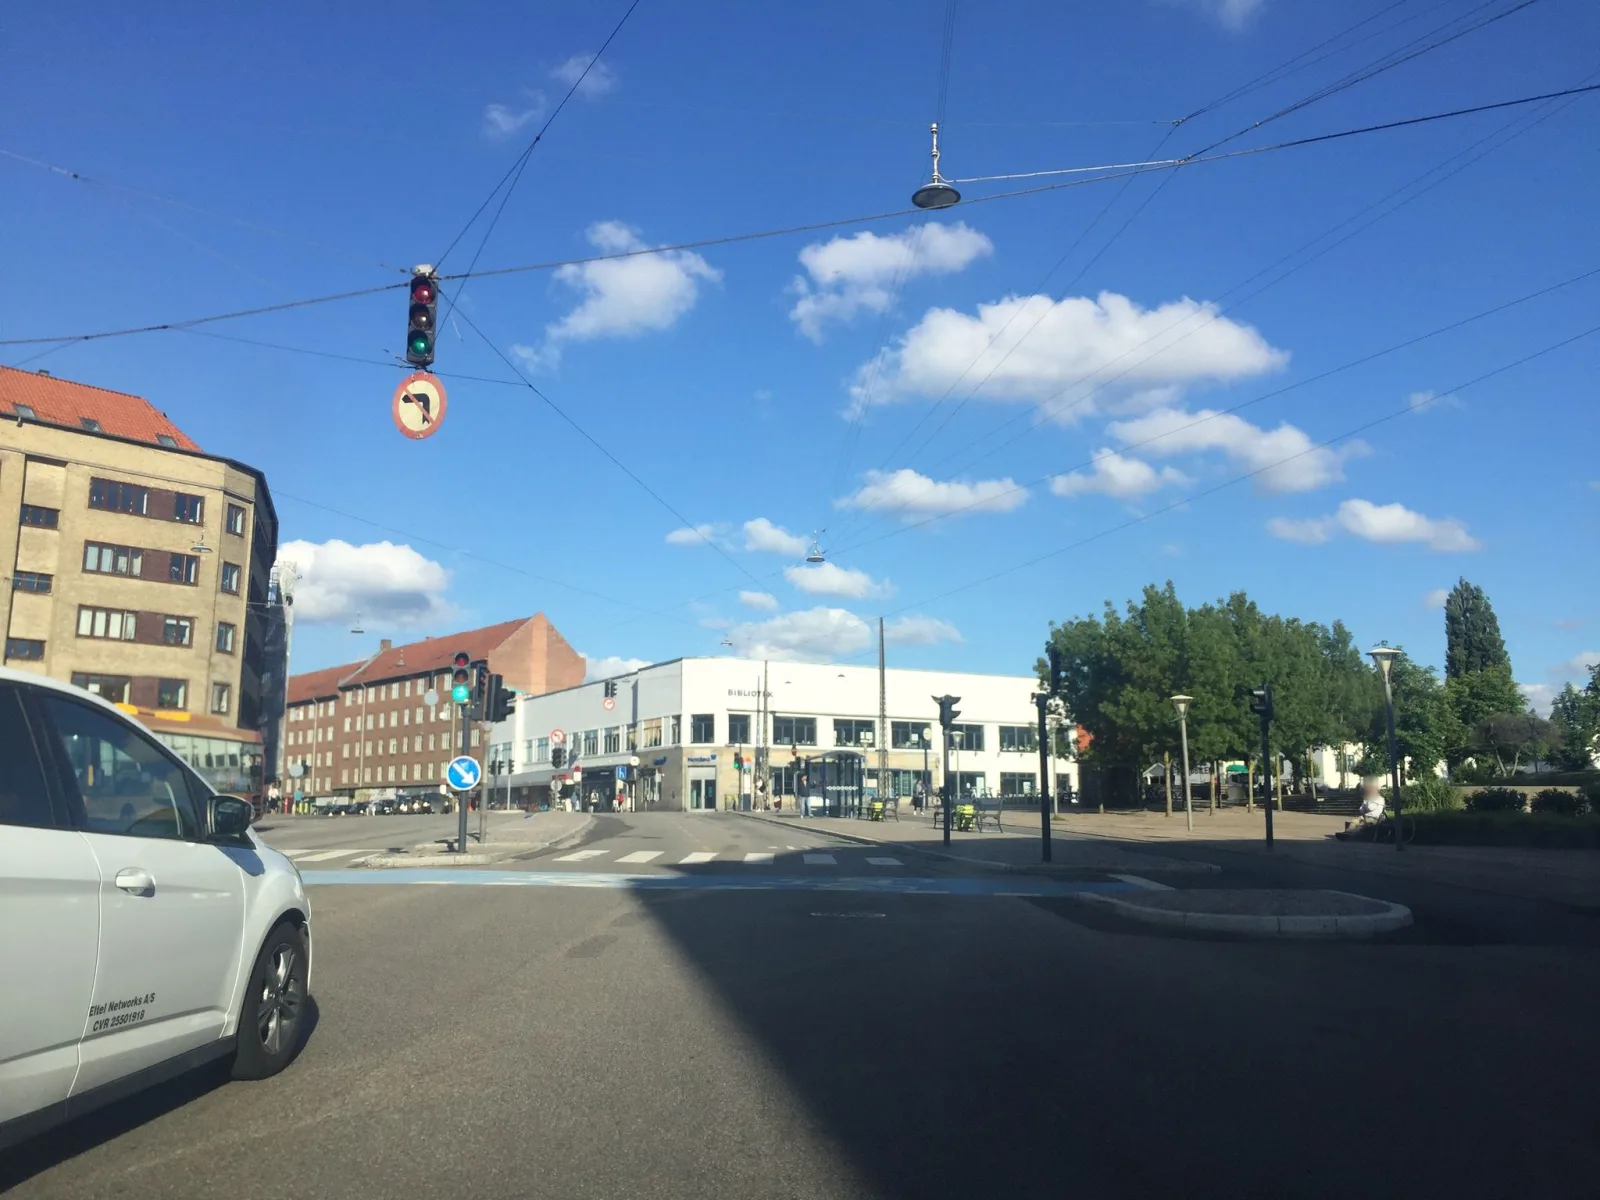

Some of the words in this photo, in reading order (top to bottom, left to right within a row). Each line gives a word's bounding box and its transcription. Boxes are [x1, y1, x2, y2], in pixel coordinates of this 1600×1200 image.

[89, 1003, 107, 1017] Eltel
[108, 996, 142, 1012] Networks
[93, 1018, 109, 1031] CVR
[110, 1009, 145, 1027] 25501918
